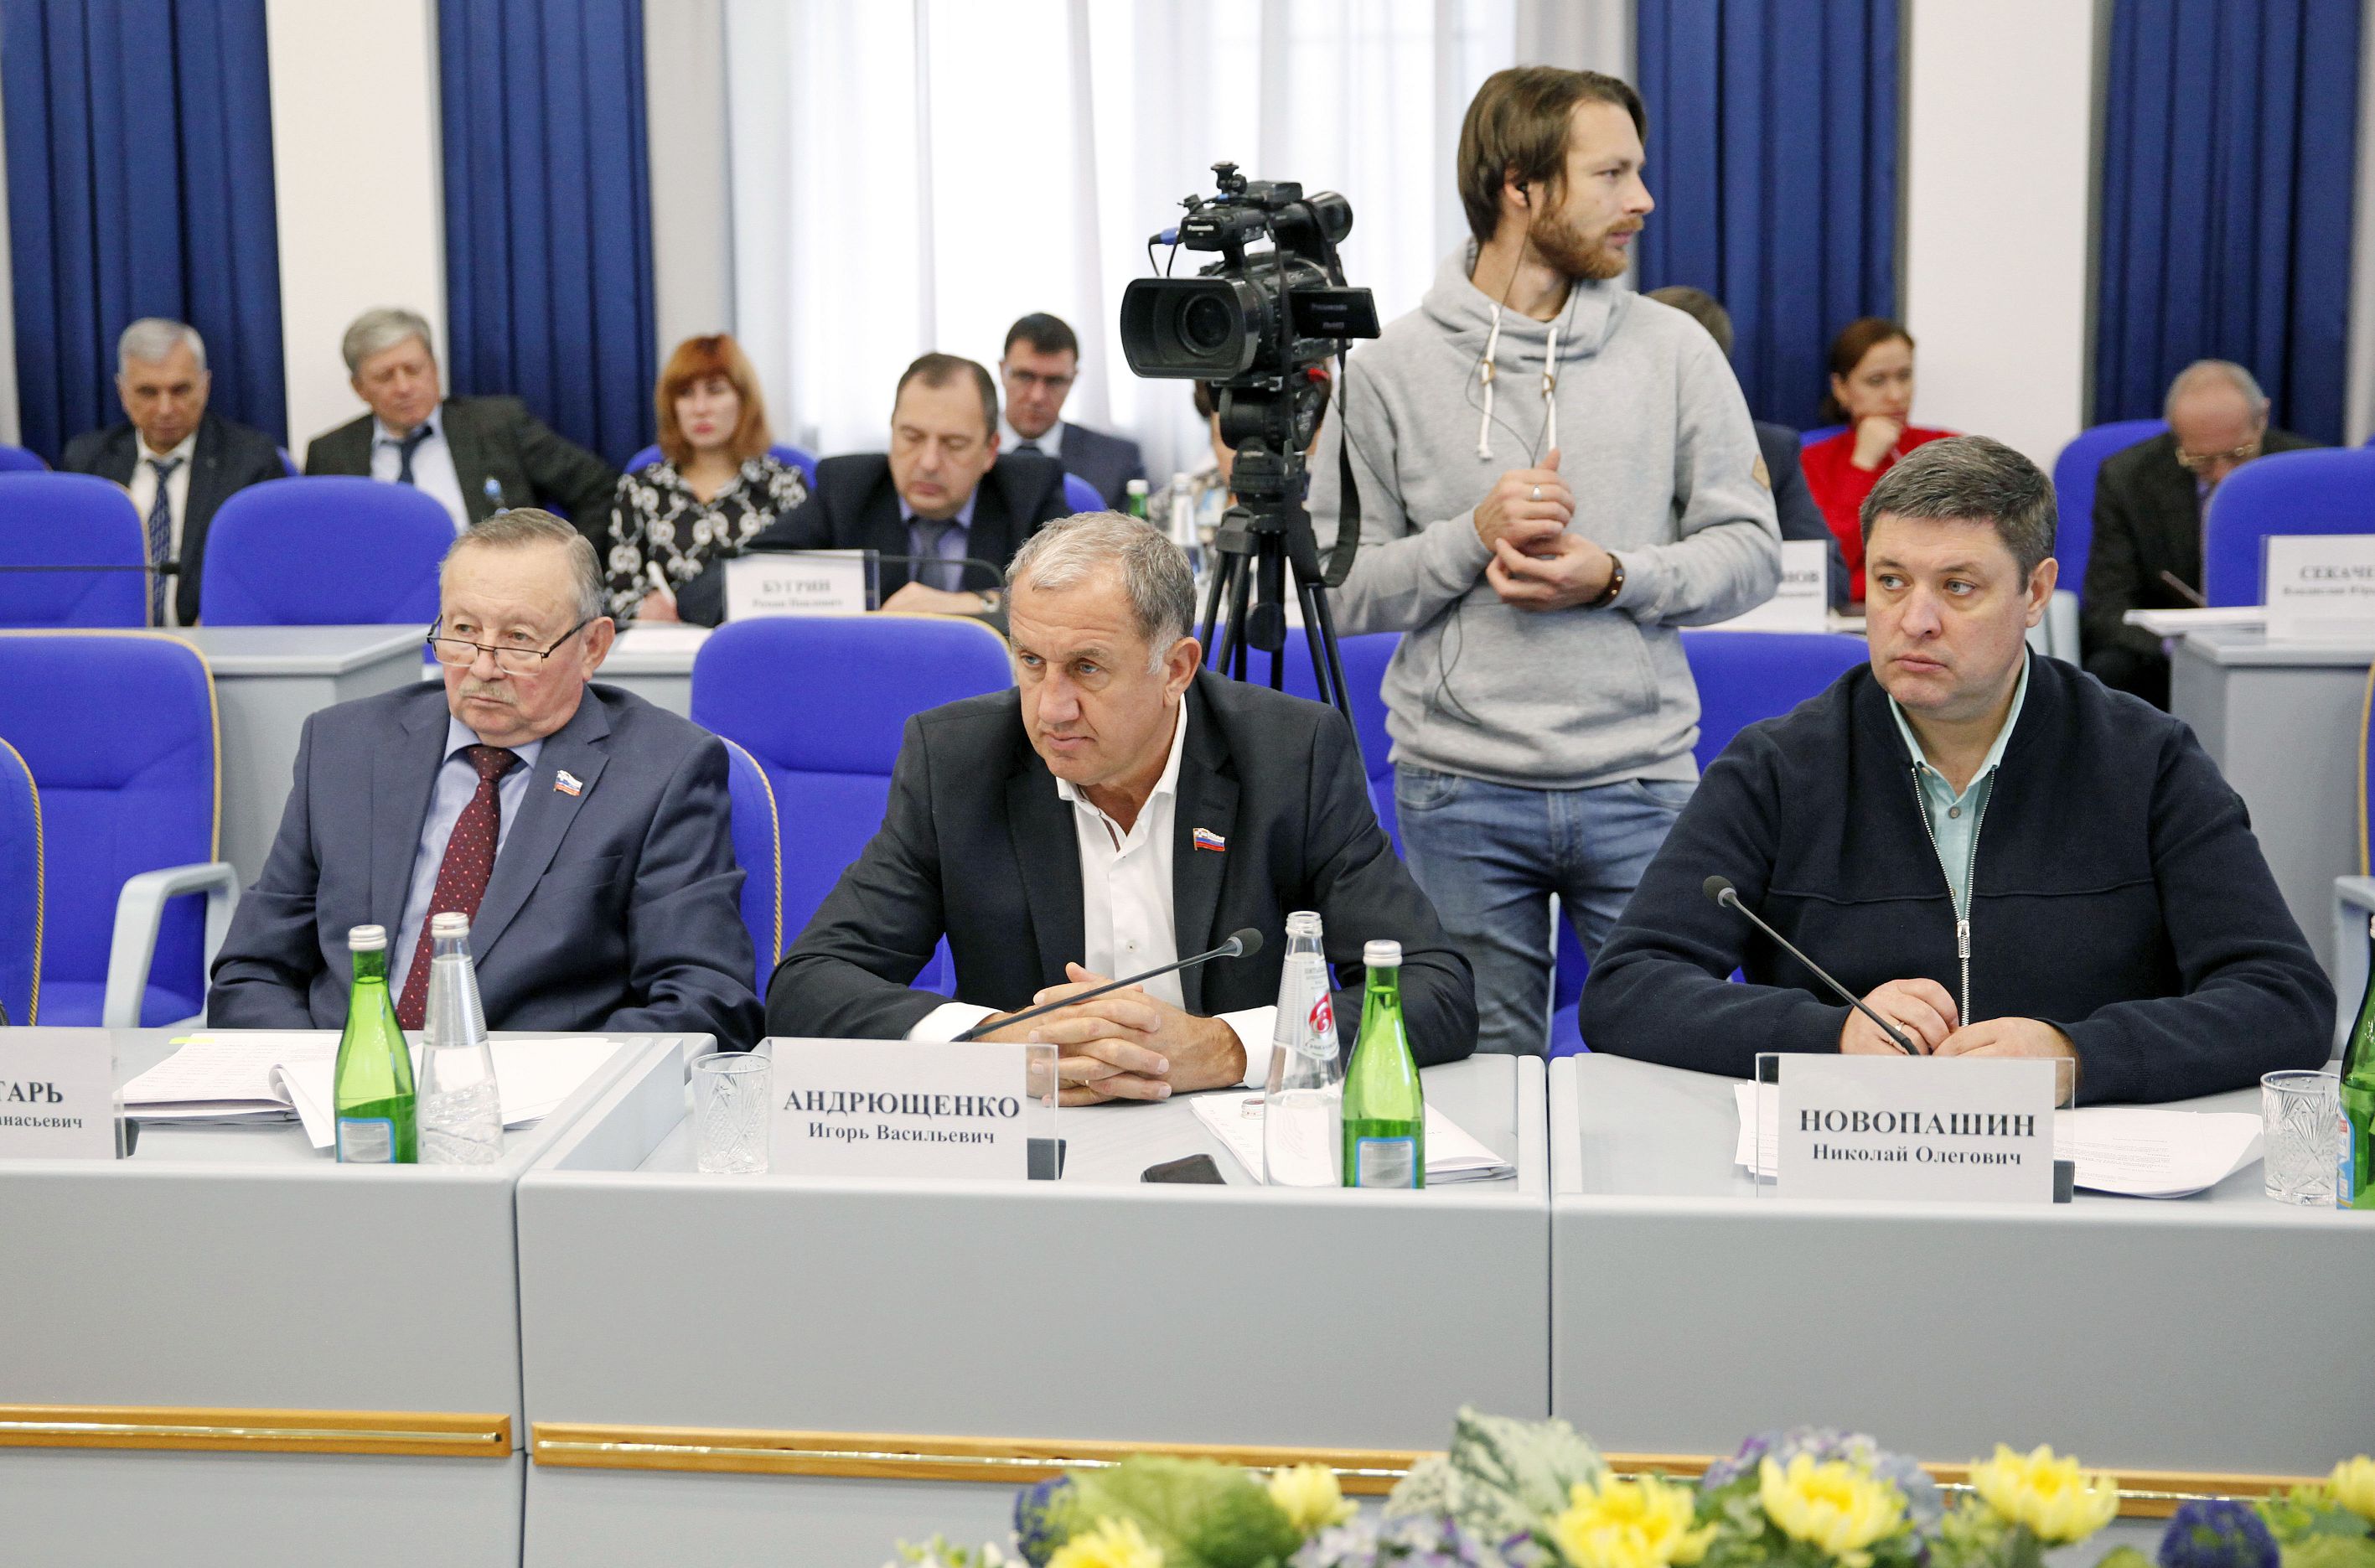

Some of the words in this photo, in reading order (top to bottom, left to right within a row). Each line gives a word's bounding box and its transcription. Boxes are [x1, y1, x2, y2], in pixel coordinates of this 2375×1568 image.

[784, 1089, 1020, 1120] АНДРЮЩЕНКО
[808, 1121, 869, 1143] Игорь
[877, 1124, 995, 1144] Васильевич
[1798, 1109, 2036, 1137] НОВОПАШИН
[1812, 1143, 1908, 1162] Николай
[1916, 1146, 2021, 1165] Олегович
